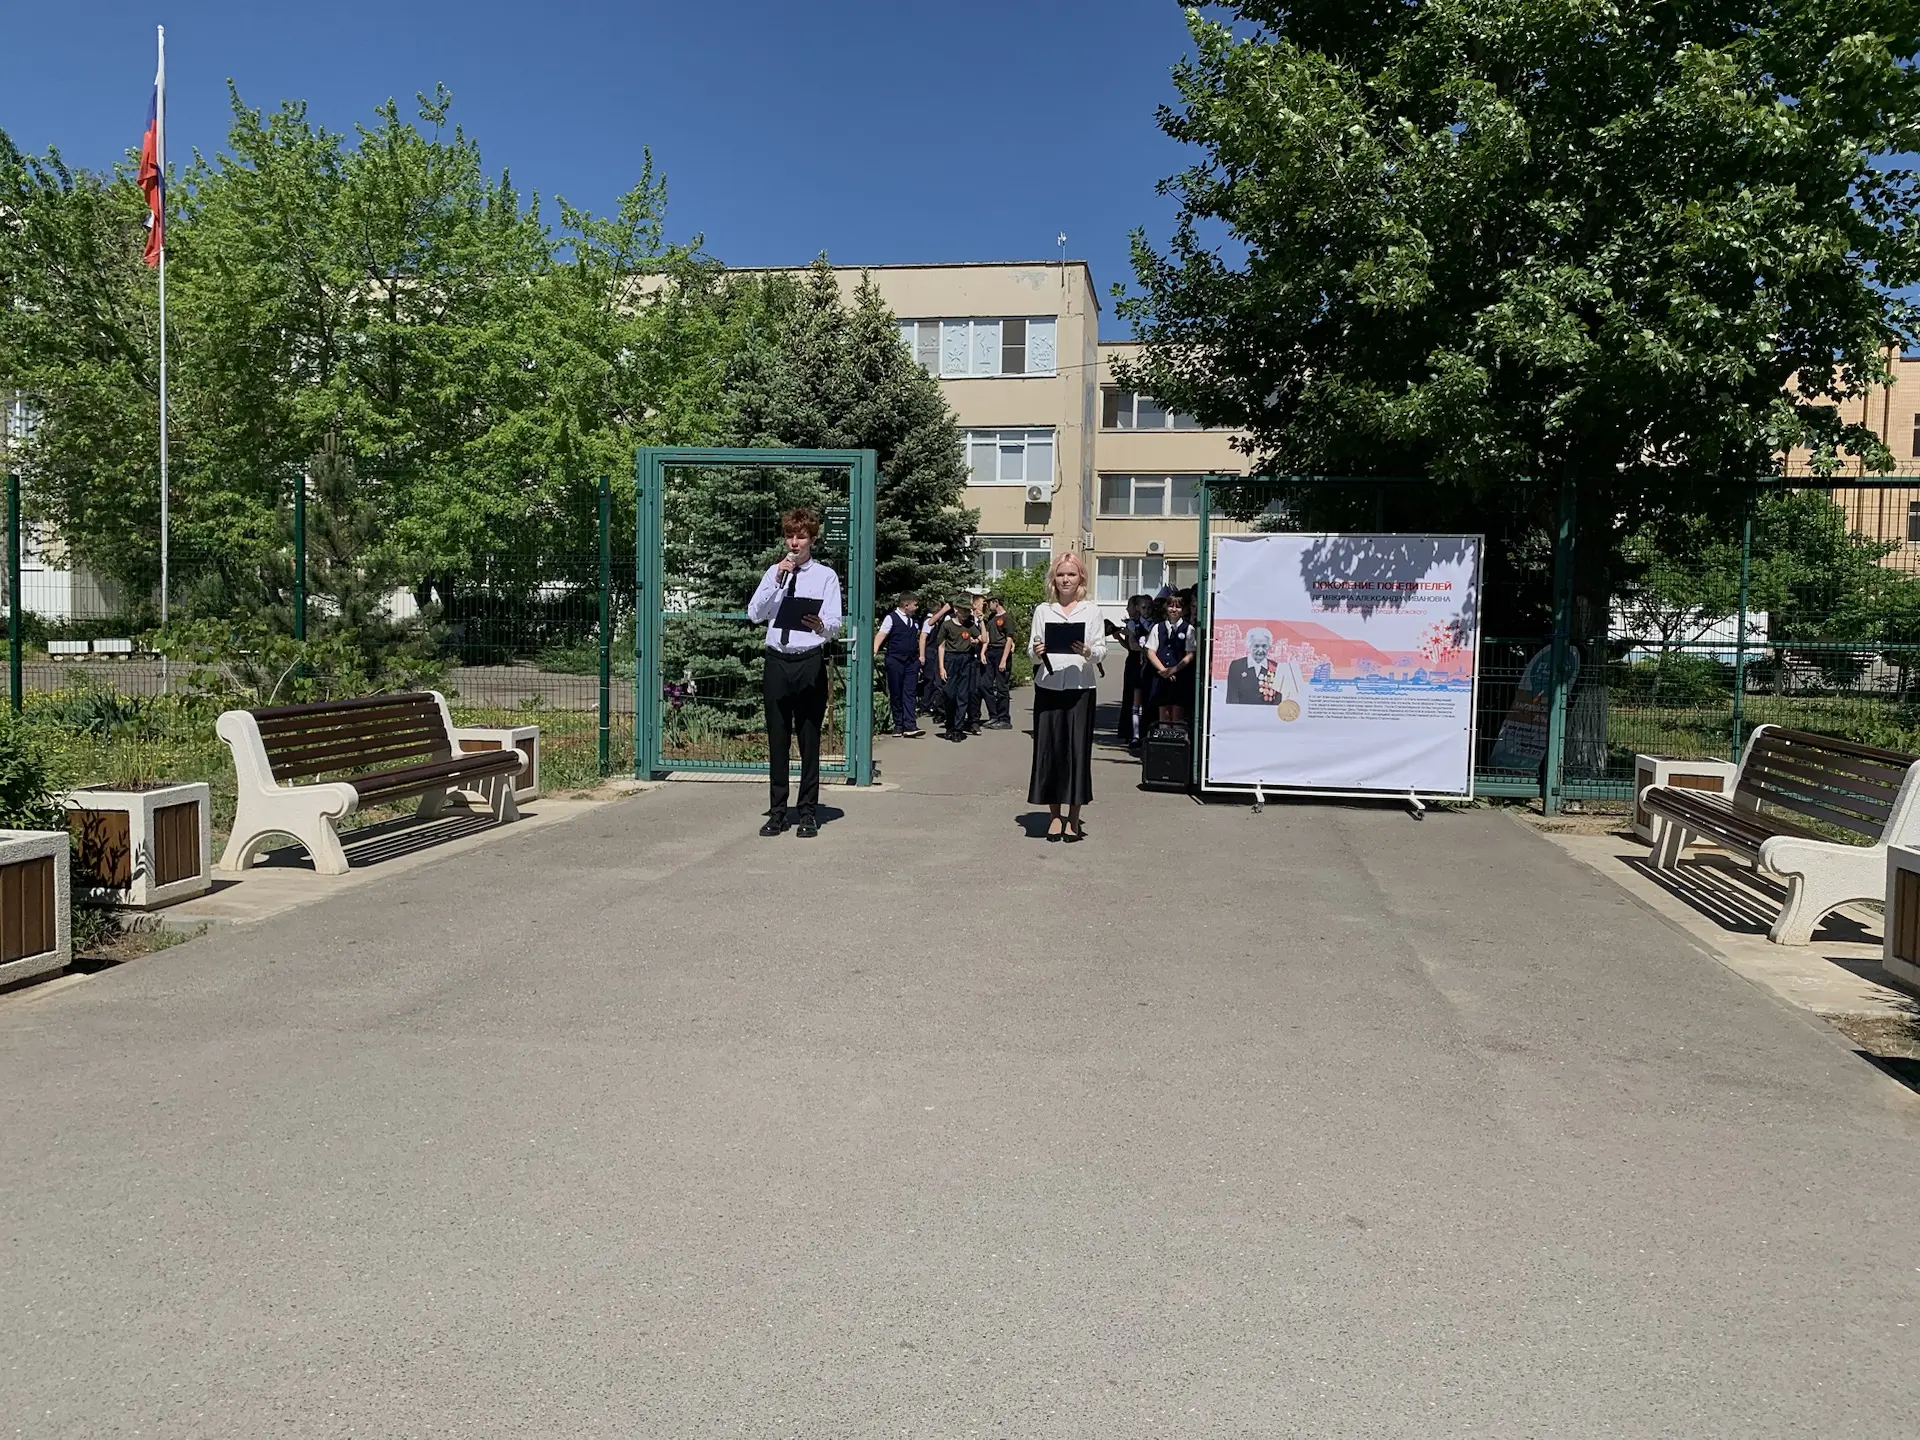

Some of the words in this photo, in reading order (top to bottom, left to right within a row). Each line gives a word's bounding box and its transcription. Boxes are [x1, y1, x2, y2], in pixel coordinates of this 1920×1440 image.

[1312, 581, 1375, 590] ПОКОЛЕНИЕ
[1377, 581, 1452, 591] ПОБЕДИТЕЛЕЙ
[1355, 595, 1407, 603] АЛЕКСАНДРА
[1408, 595, 1451, 603] ИВАНОВНА
